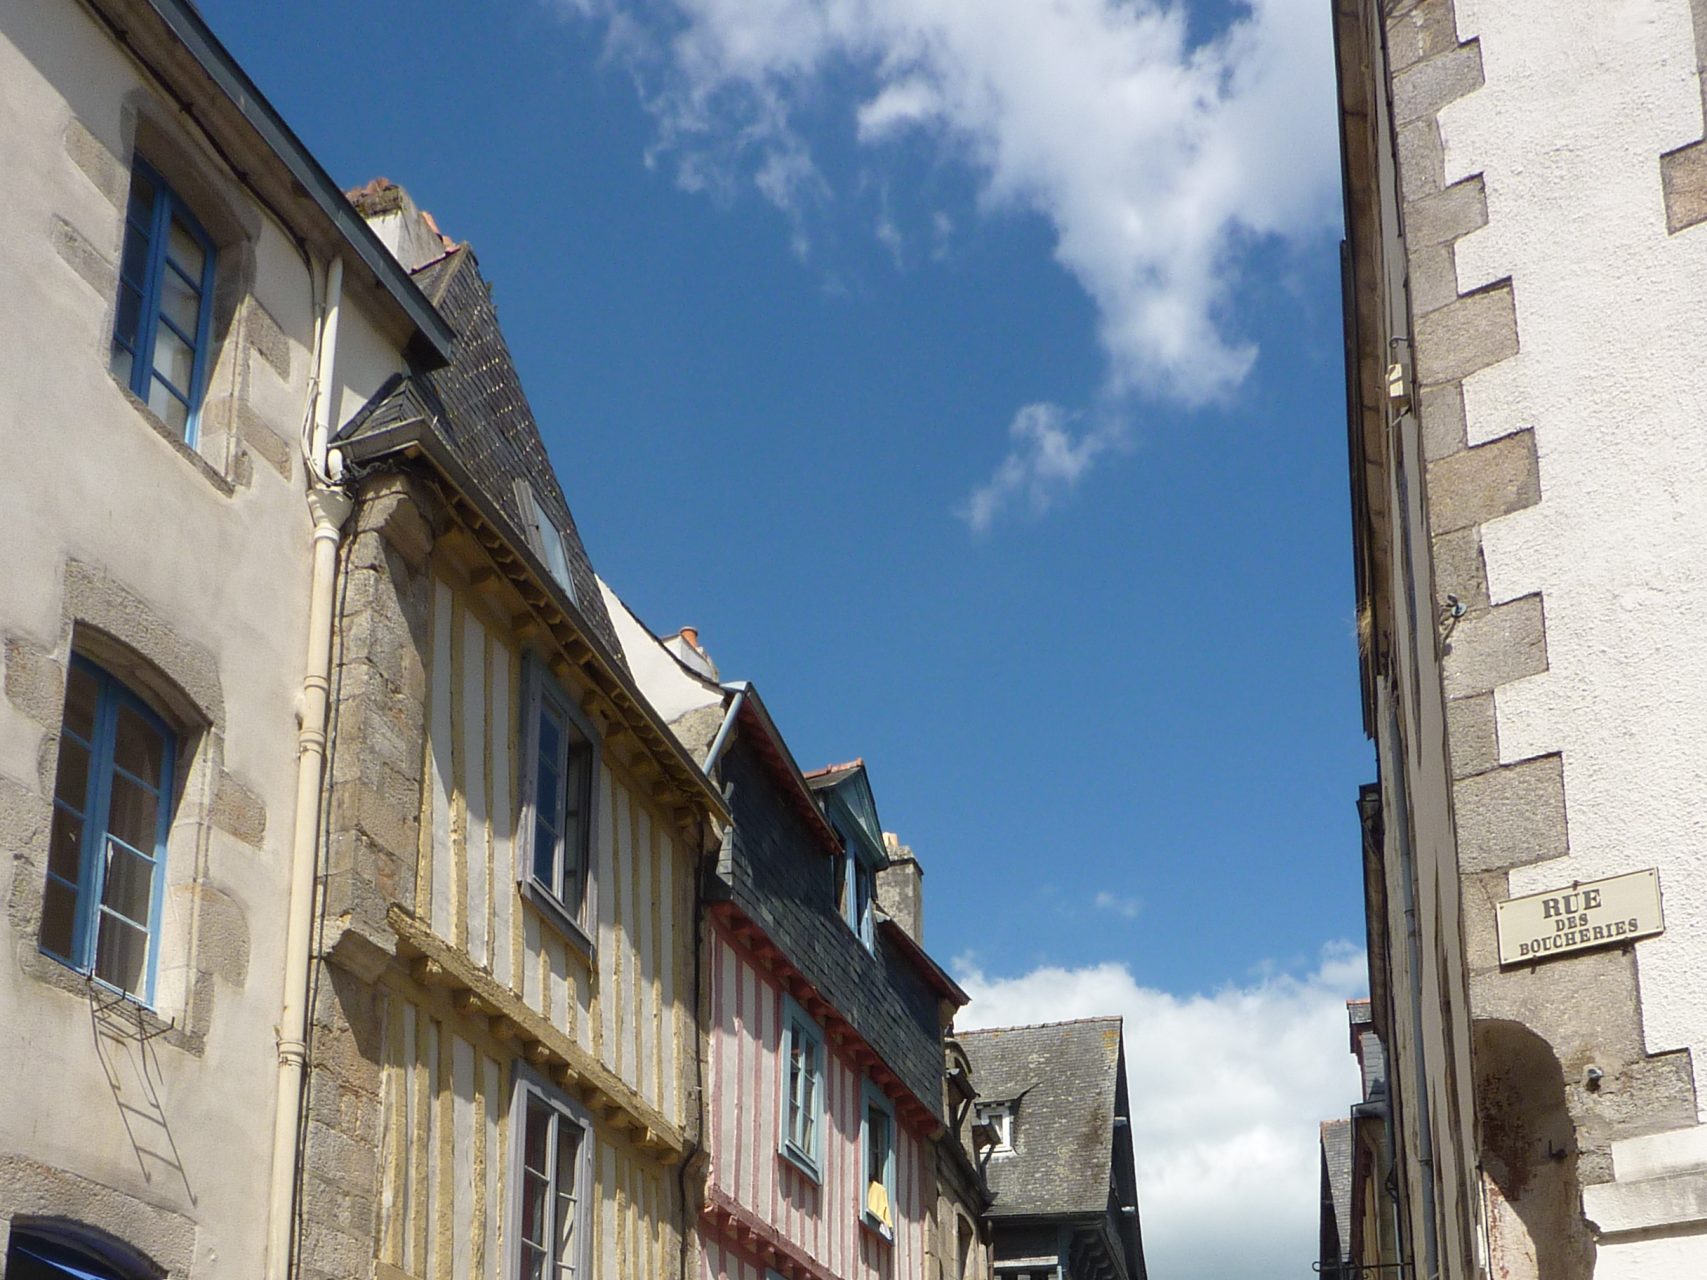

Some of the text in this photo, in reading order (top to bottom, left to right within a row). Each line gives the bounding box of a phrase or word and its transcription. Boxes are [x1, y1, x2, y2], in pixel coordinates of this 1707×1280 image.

[1542, 888, 1602, 919] RUE
[1519, 918, 1639, 956] BOUCHERIES
[1555, 913, 1589, 933] DES
